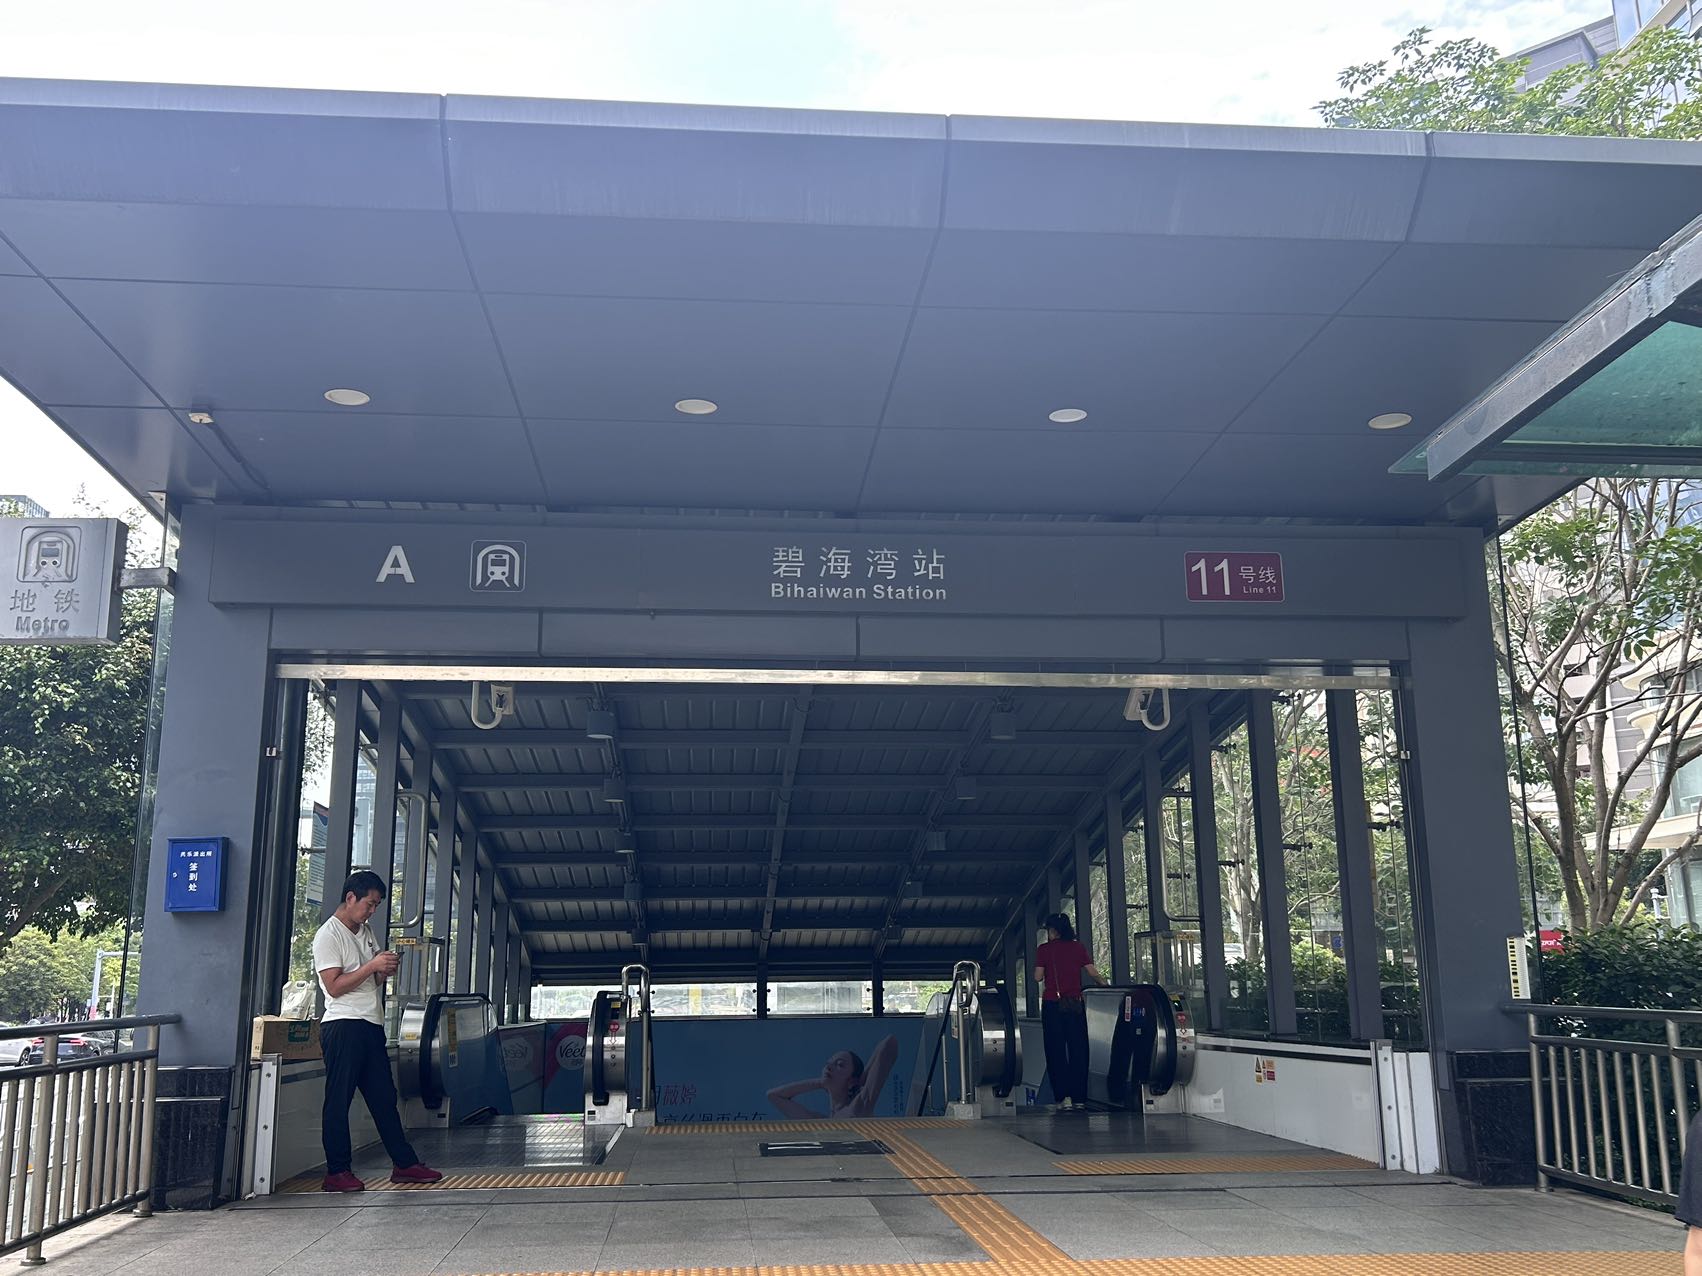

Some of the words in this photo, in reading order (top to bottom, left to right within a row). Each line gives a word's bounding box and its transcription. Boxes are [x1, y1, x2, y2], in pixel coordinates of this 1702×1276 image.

[376, 545, 415, 583] A
[772, 546, 945, 580] 碧海湾站
[1191, 558, 1231, 596] 11
[1239, 566, 1277, 584] 号线
[9, 588, 80, 613] 地铁
[771, 583, 866, 599] Bihaiwan
[873, 584, 947, 600] Station
[1243, 586, 1264, 594] Line
[1266, 586, 1277, 594] 11
[15, 616, 70, 633] Metro
[188, 862, 198, 892] 签到处
[560, 1041, 586, 1058] Veet
